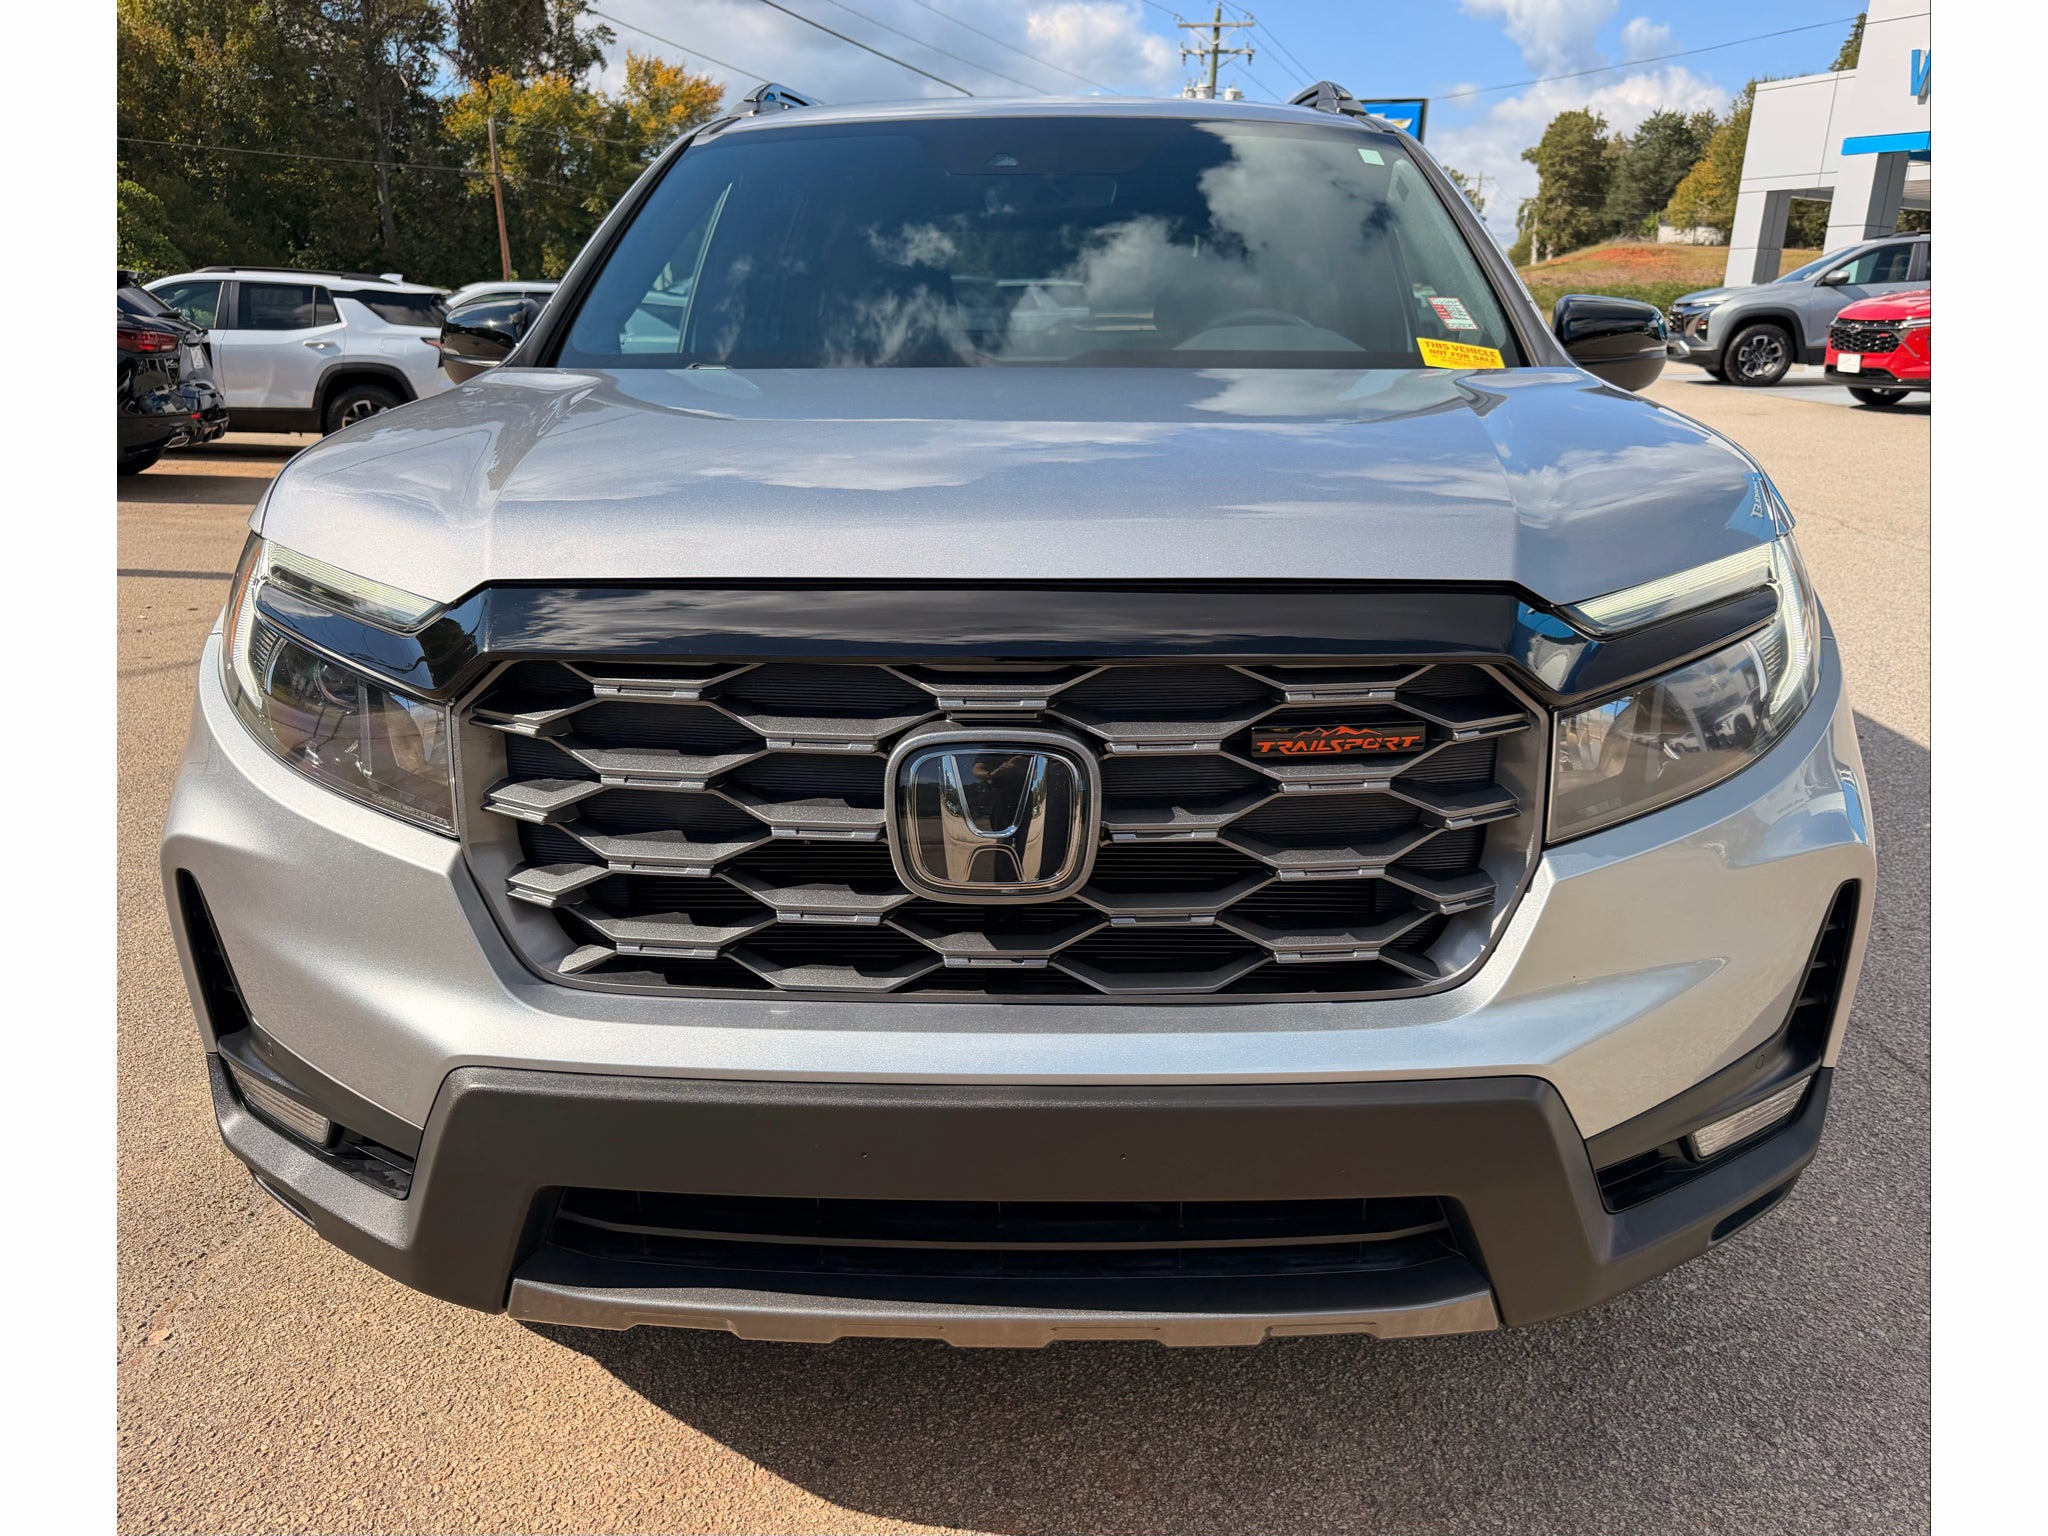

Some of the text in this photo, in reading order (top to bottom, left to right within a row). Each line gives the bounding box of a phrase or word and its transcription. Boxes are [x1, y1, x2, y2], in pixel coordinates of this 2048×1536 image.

[1425, 341, 1497, 358] THIS VEHICLE
[1473, 355, 1496, 363] SALE
[1256, 735, 1420, 755] TRAILSPORT
